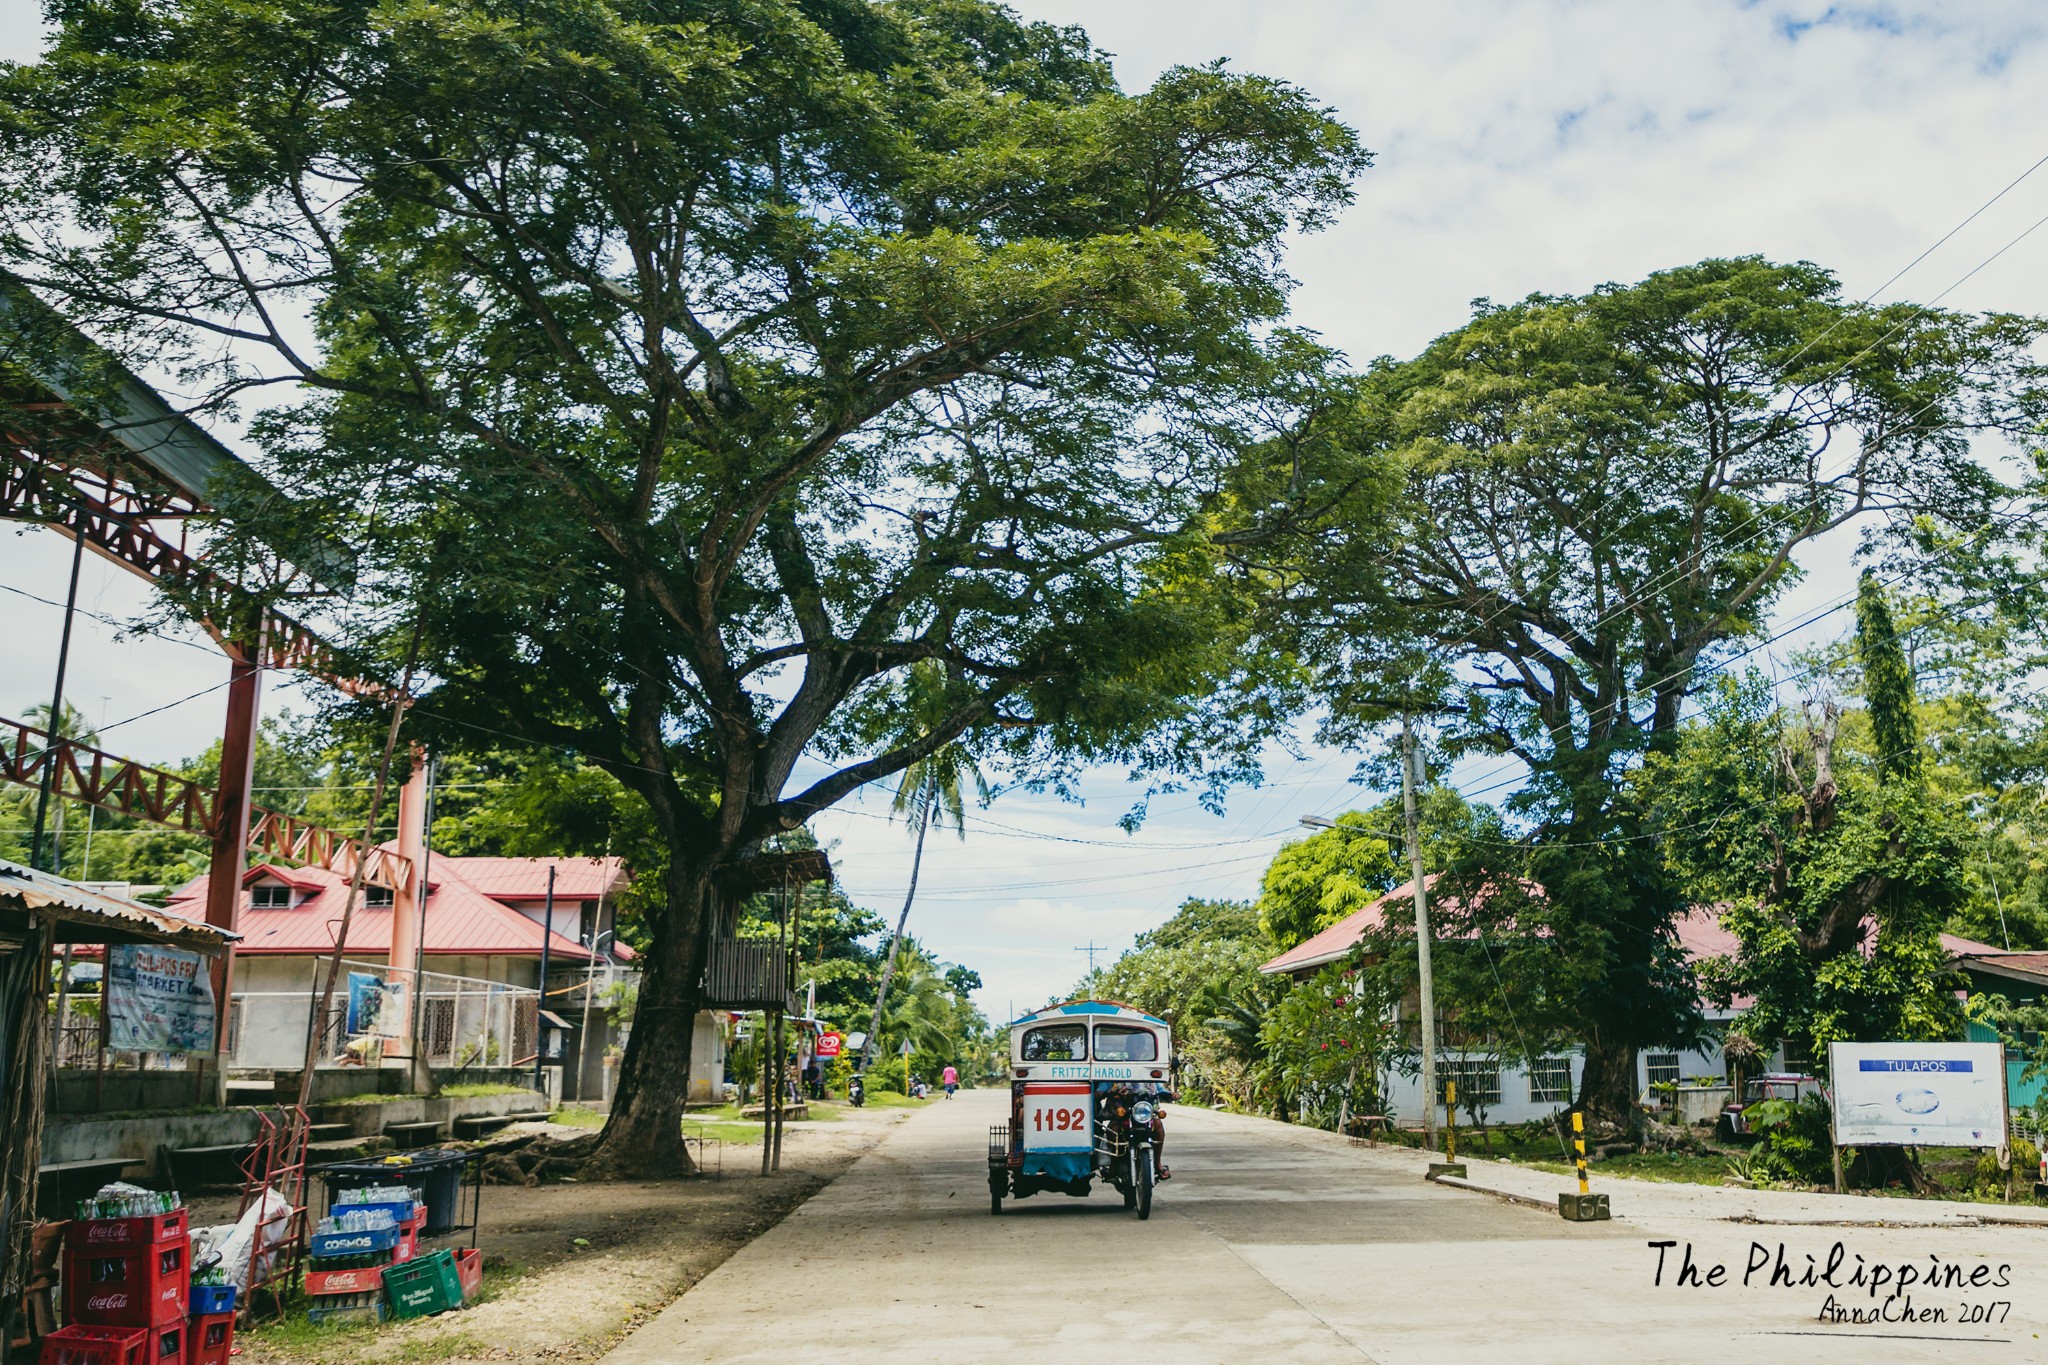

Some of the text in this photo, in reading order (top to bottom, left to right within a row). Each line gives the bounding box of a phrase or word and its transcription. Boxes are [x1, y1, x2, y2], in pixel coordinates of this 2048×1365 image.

[1886, 1060, 1947, 1072] TULAPOS
[1051, 1067, 1132, 1079] FRITTZ HAROLD
[1033, 1108, 1085, 1132] 1192
[324, 1236, 372, 1250] COSMOS
